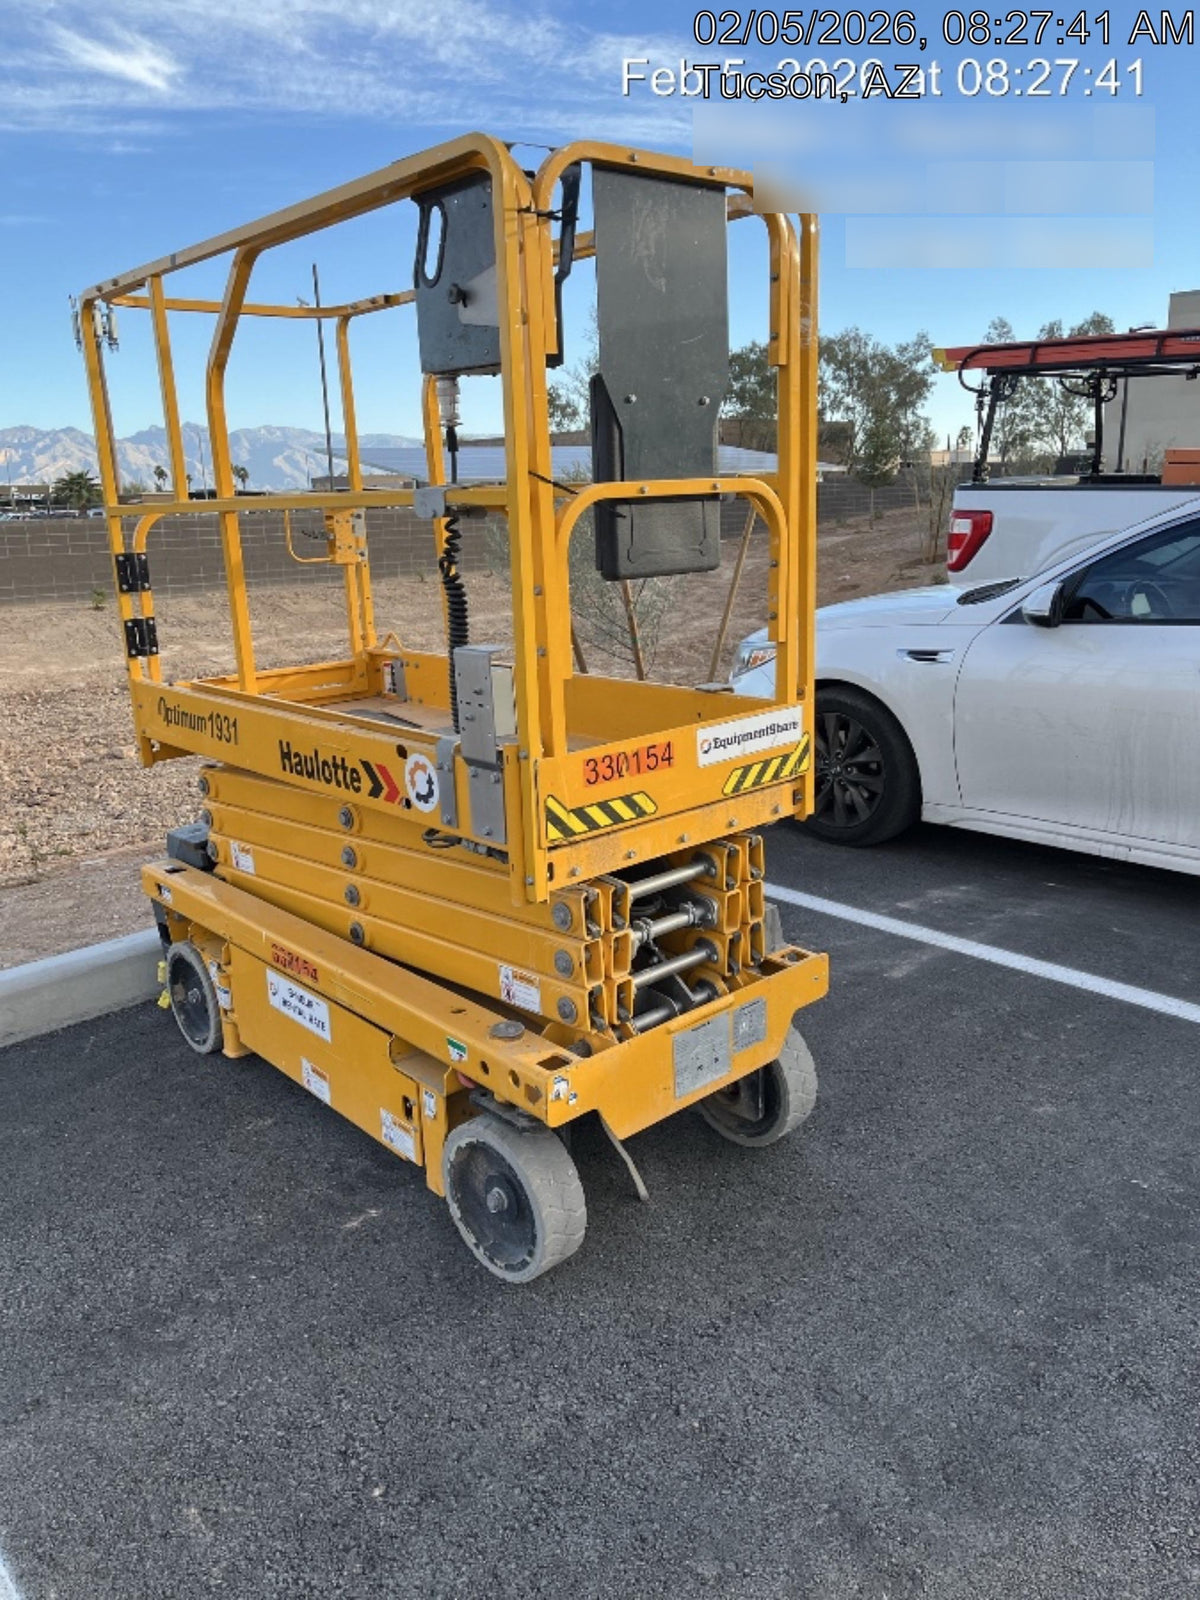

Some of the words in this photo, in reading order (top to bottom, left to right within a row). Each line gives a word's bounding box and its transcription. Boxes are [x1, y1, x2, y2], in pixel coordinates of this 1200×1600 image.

[712, 720, 799, 750] EquipmentShare
[278, 739, 362, 793] Haulotte
[585, 741, 674, 785] 330154
